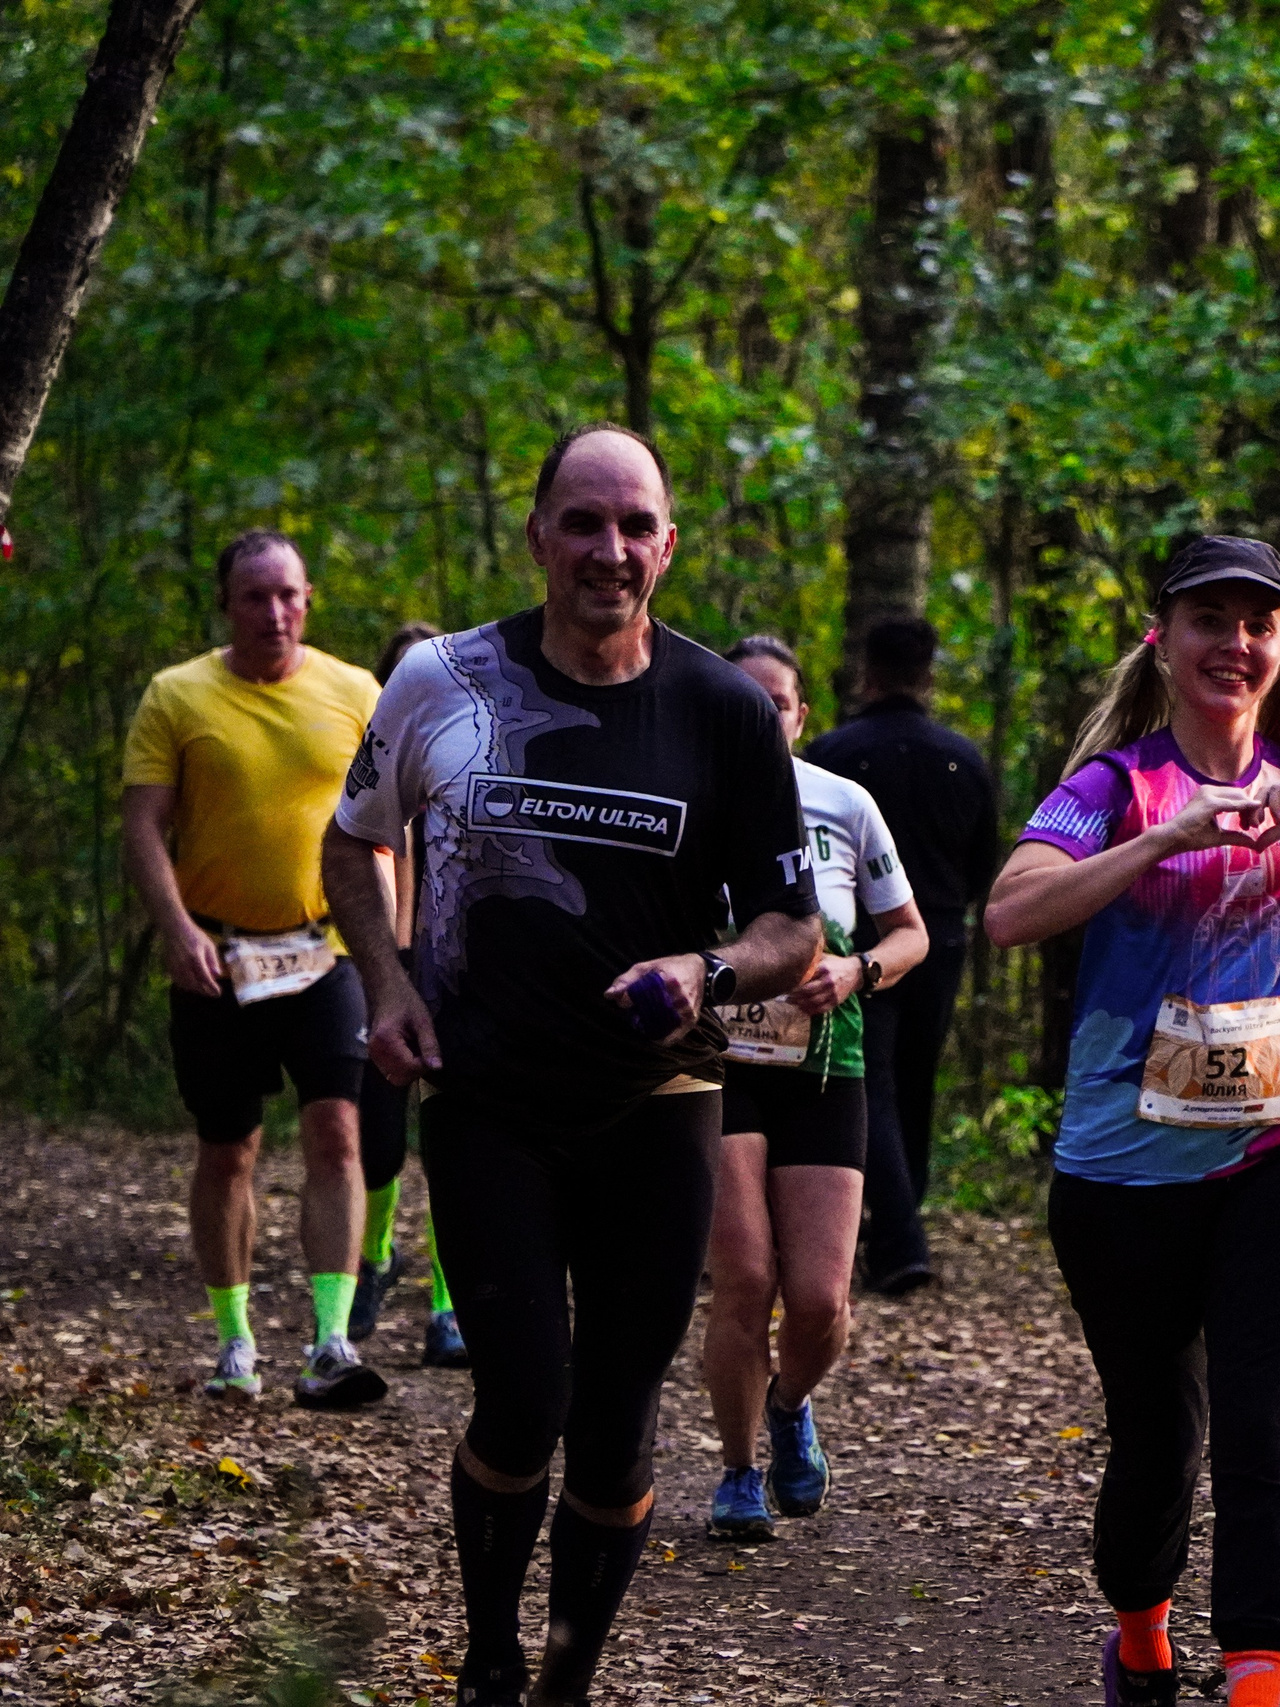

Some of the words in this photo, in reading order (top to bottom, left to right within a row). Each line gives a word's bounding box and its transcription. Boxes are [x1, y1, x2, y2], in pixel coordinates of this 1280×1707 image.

[518, 797, 593, 822] ELTON
[598, 808, 668, 835] ULTRA
[1205, 1047, 1249, 1079] 52
[1201, 1082, 1248, 1099] Юлия
